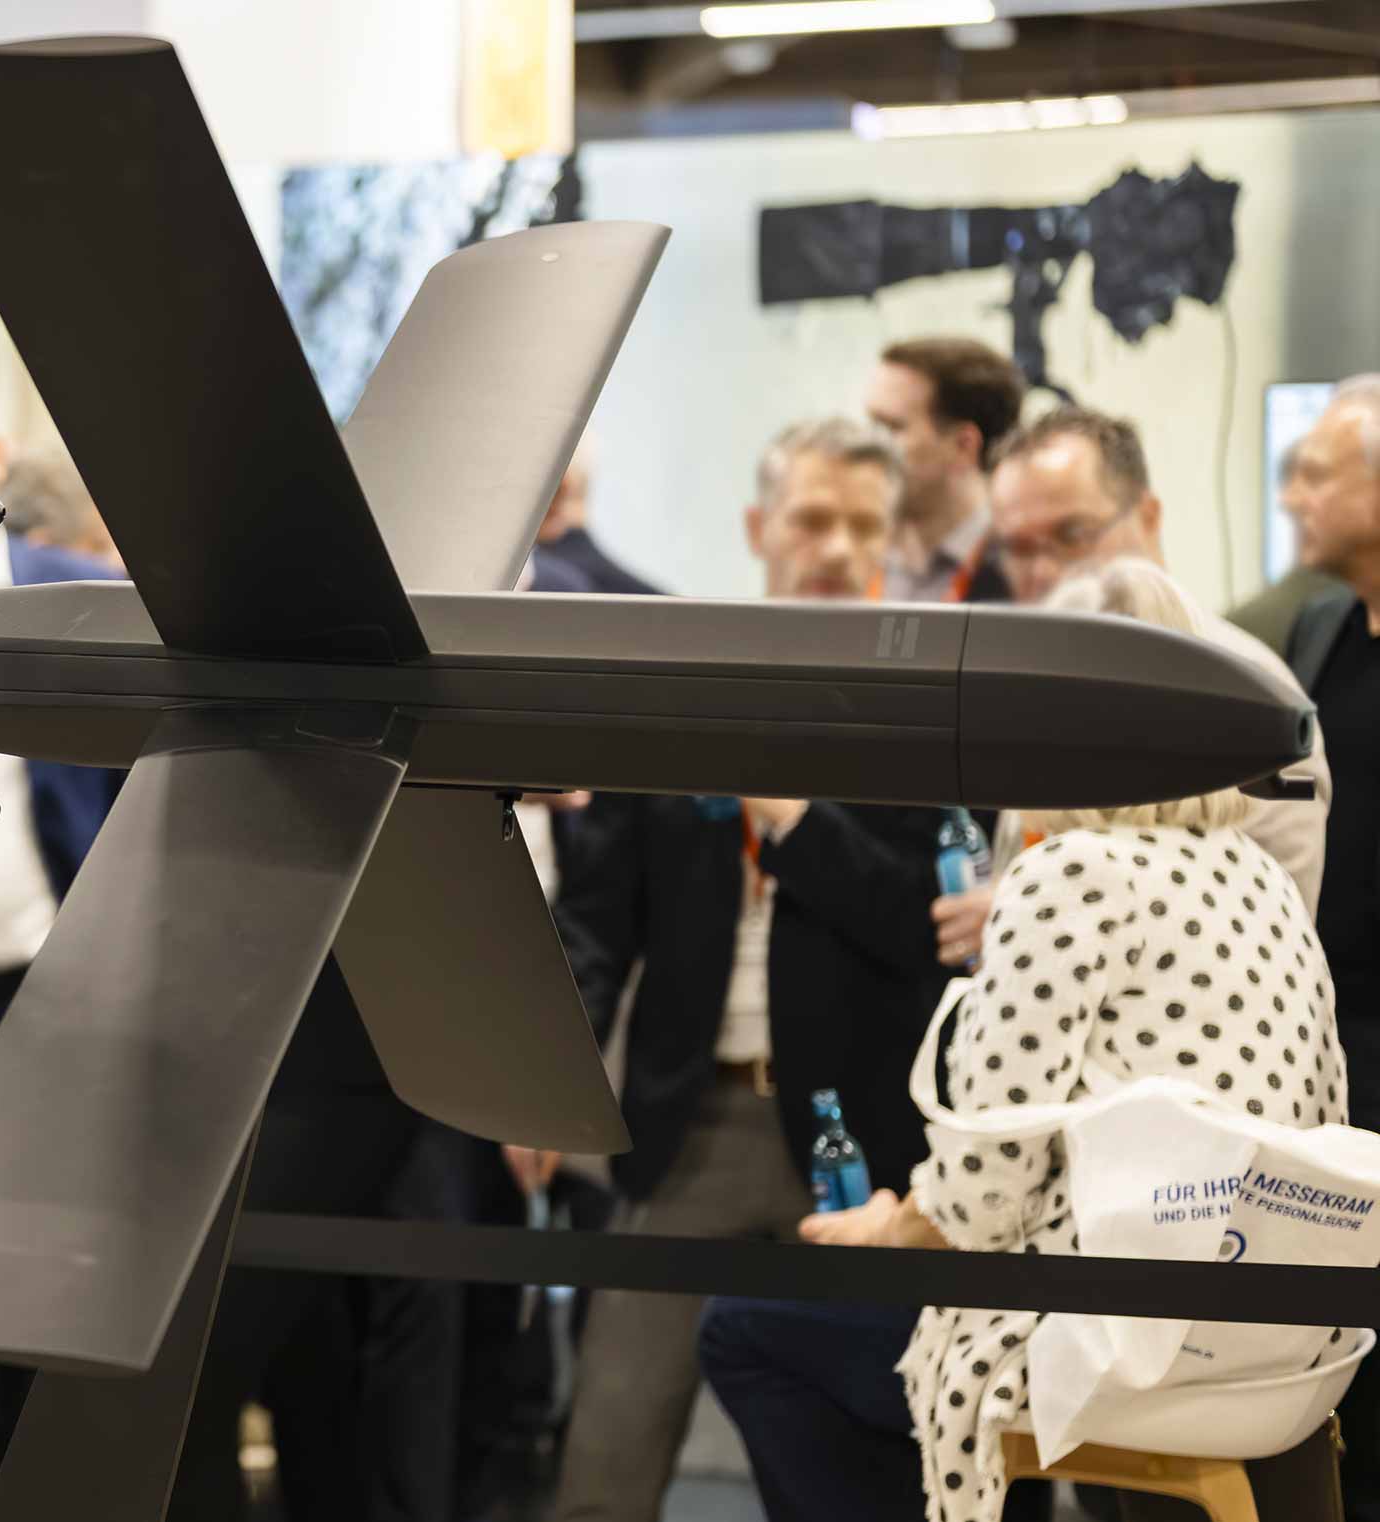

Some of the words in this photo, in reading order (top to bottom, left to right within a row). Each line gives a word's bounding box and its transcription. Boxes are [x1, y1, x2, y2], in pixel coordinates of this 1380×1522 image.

[1203, 1175, 1241, 1198] IHR
[1253, 1173, 1374, 1215] MESSEKRAM
[1154, 1209, 1186, 1224] UND
[1191, 1206, 1215, 1220] DIE
